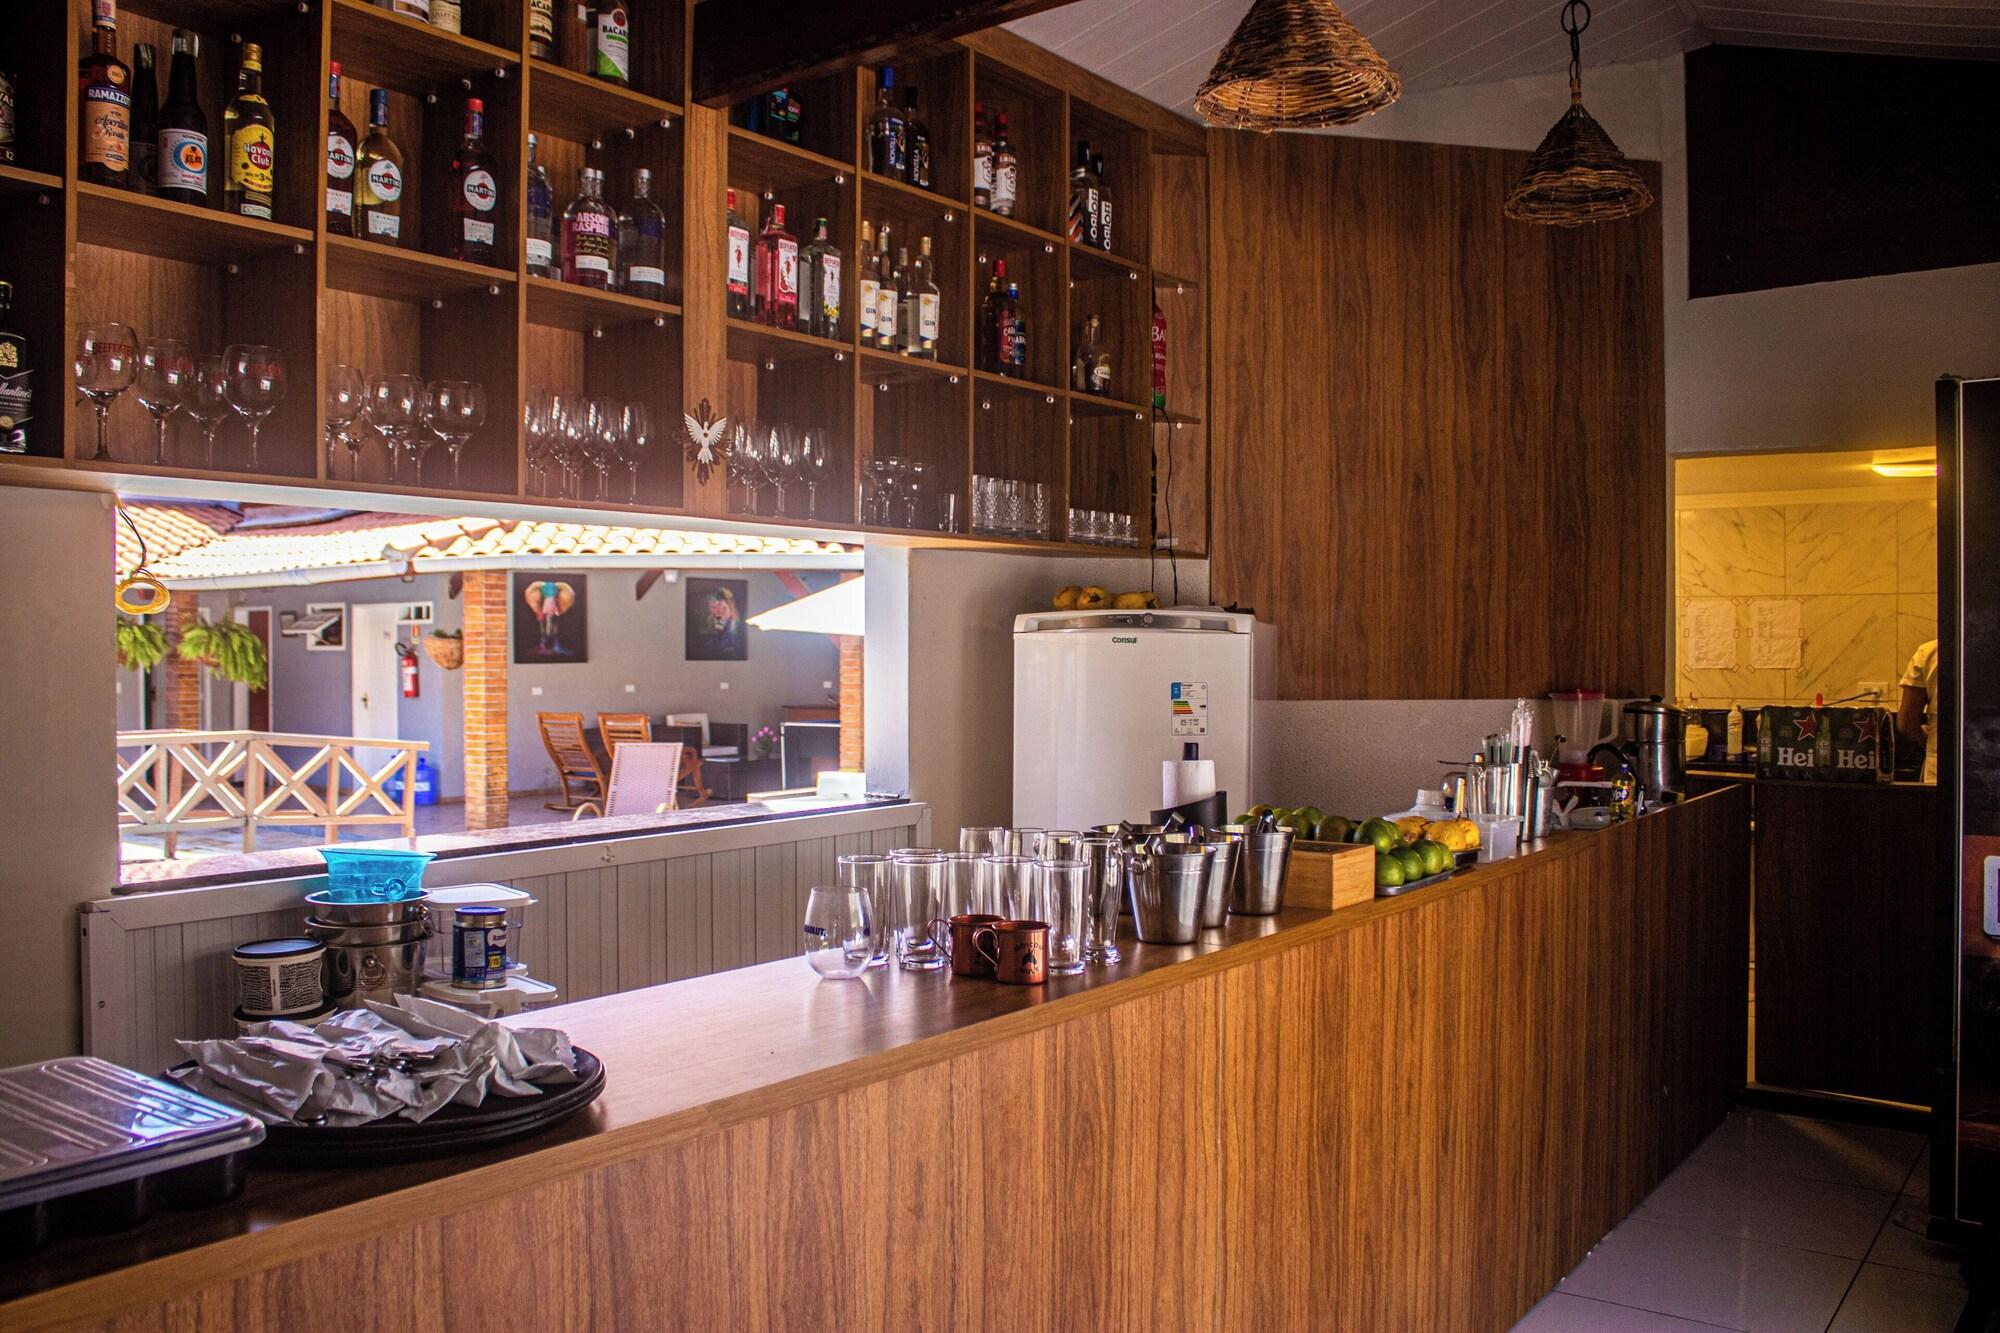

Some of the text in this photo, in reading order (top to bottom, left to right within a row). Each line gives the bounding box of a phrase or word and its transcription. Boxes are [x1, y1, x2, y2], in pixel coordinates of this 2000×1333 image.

[251, 154, 270, 167] Club
[1777, 747, 1815, 767] Hei
[1837, 749, 1876, 769] Hei
